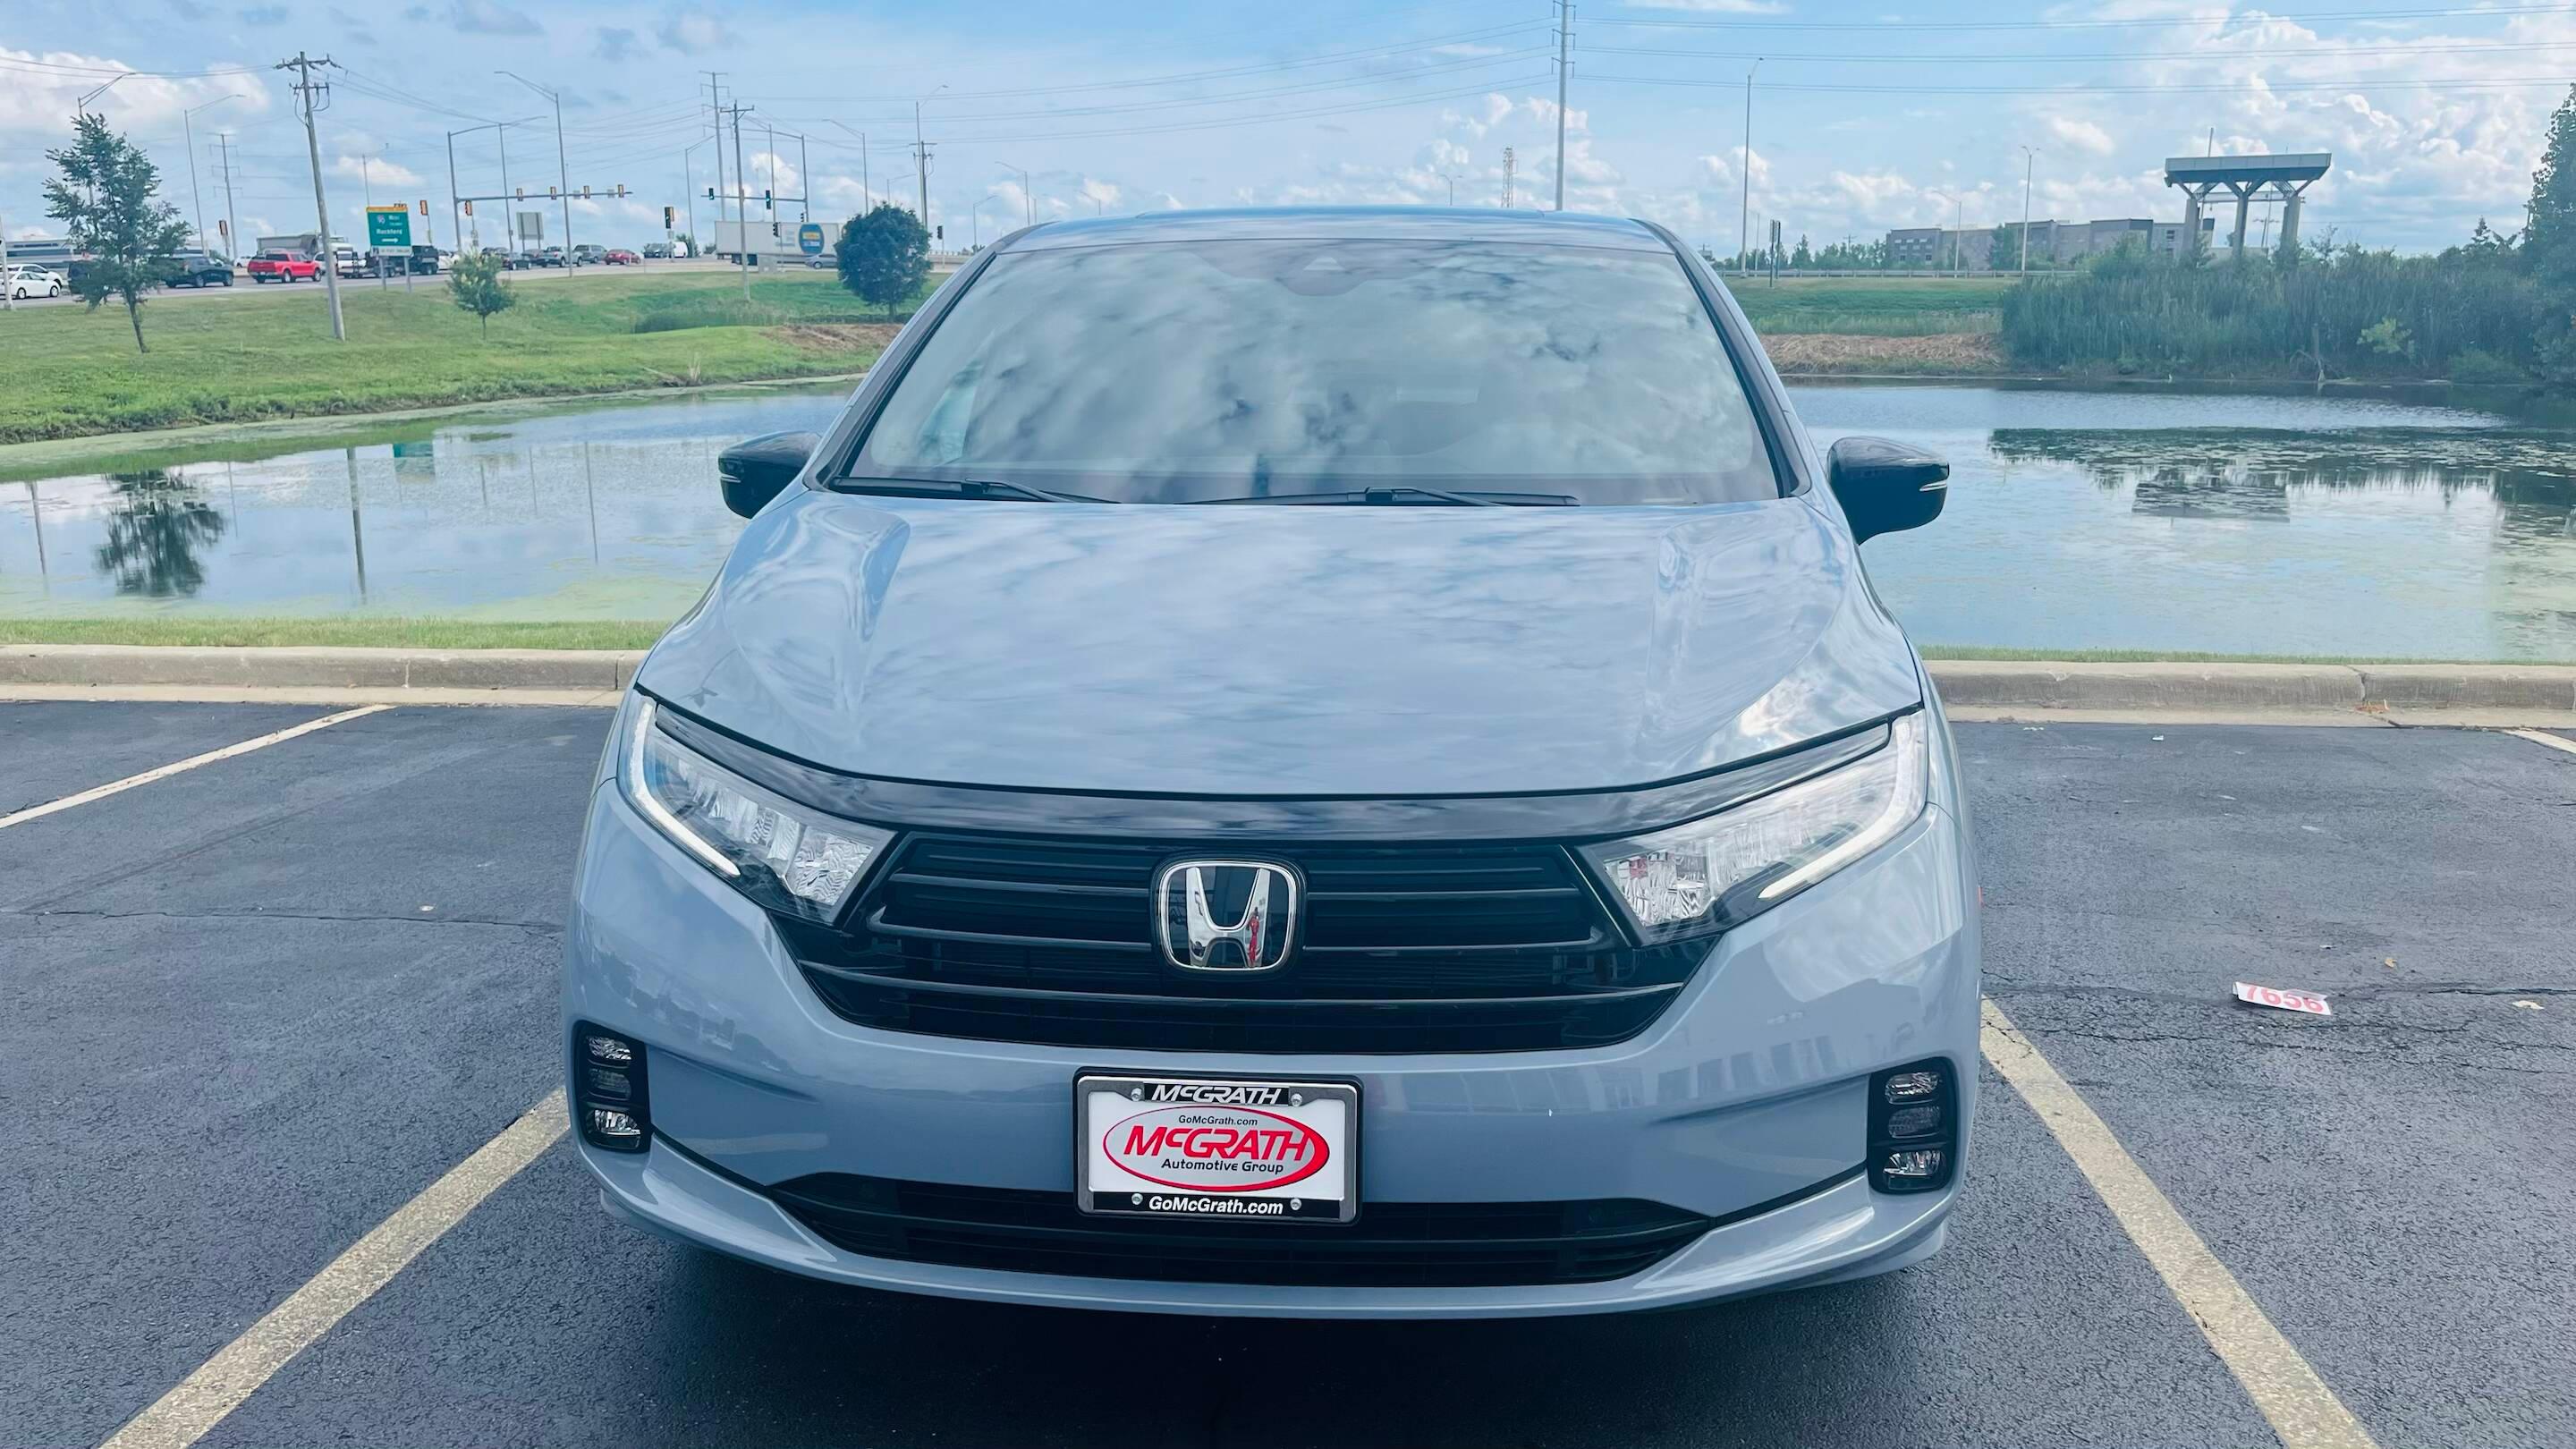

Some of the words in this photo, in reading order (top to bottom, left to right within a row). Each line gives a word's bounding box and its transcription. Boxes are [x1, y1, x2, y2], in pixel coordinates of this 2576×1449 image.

[1178, 1114, 1258, 1126] GoMcGrath.com
[1161, 1158, 1239, 1172] Automotive
[1241, 1161, 1284, 1175] Group
[1148, 1195, 1284, 1215] GoMcGrath.com
